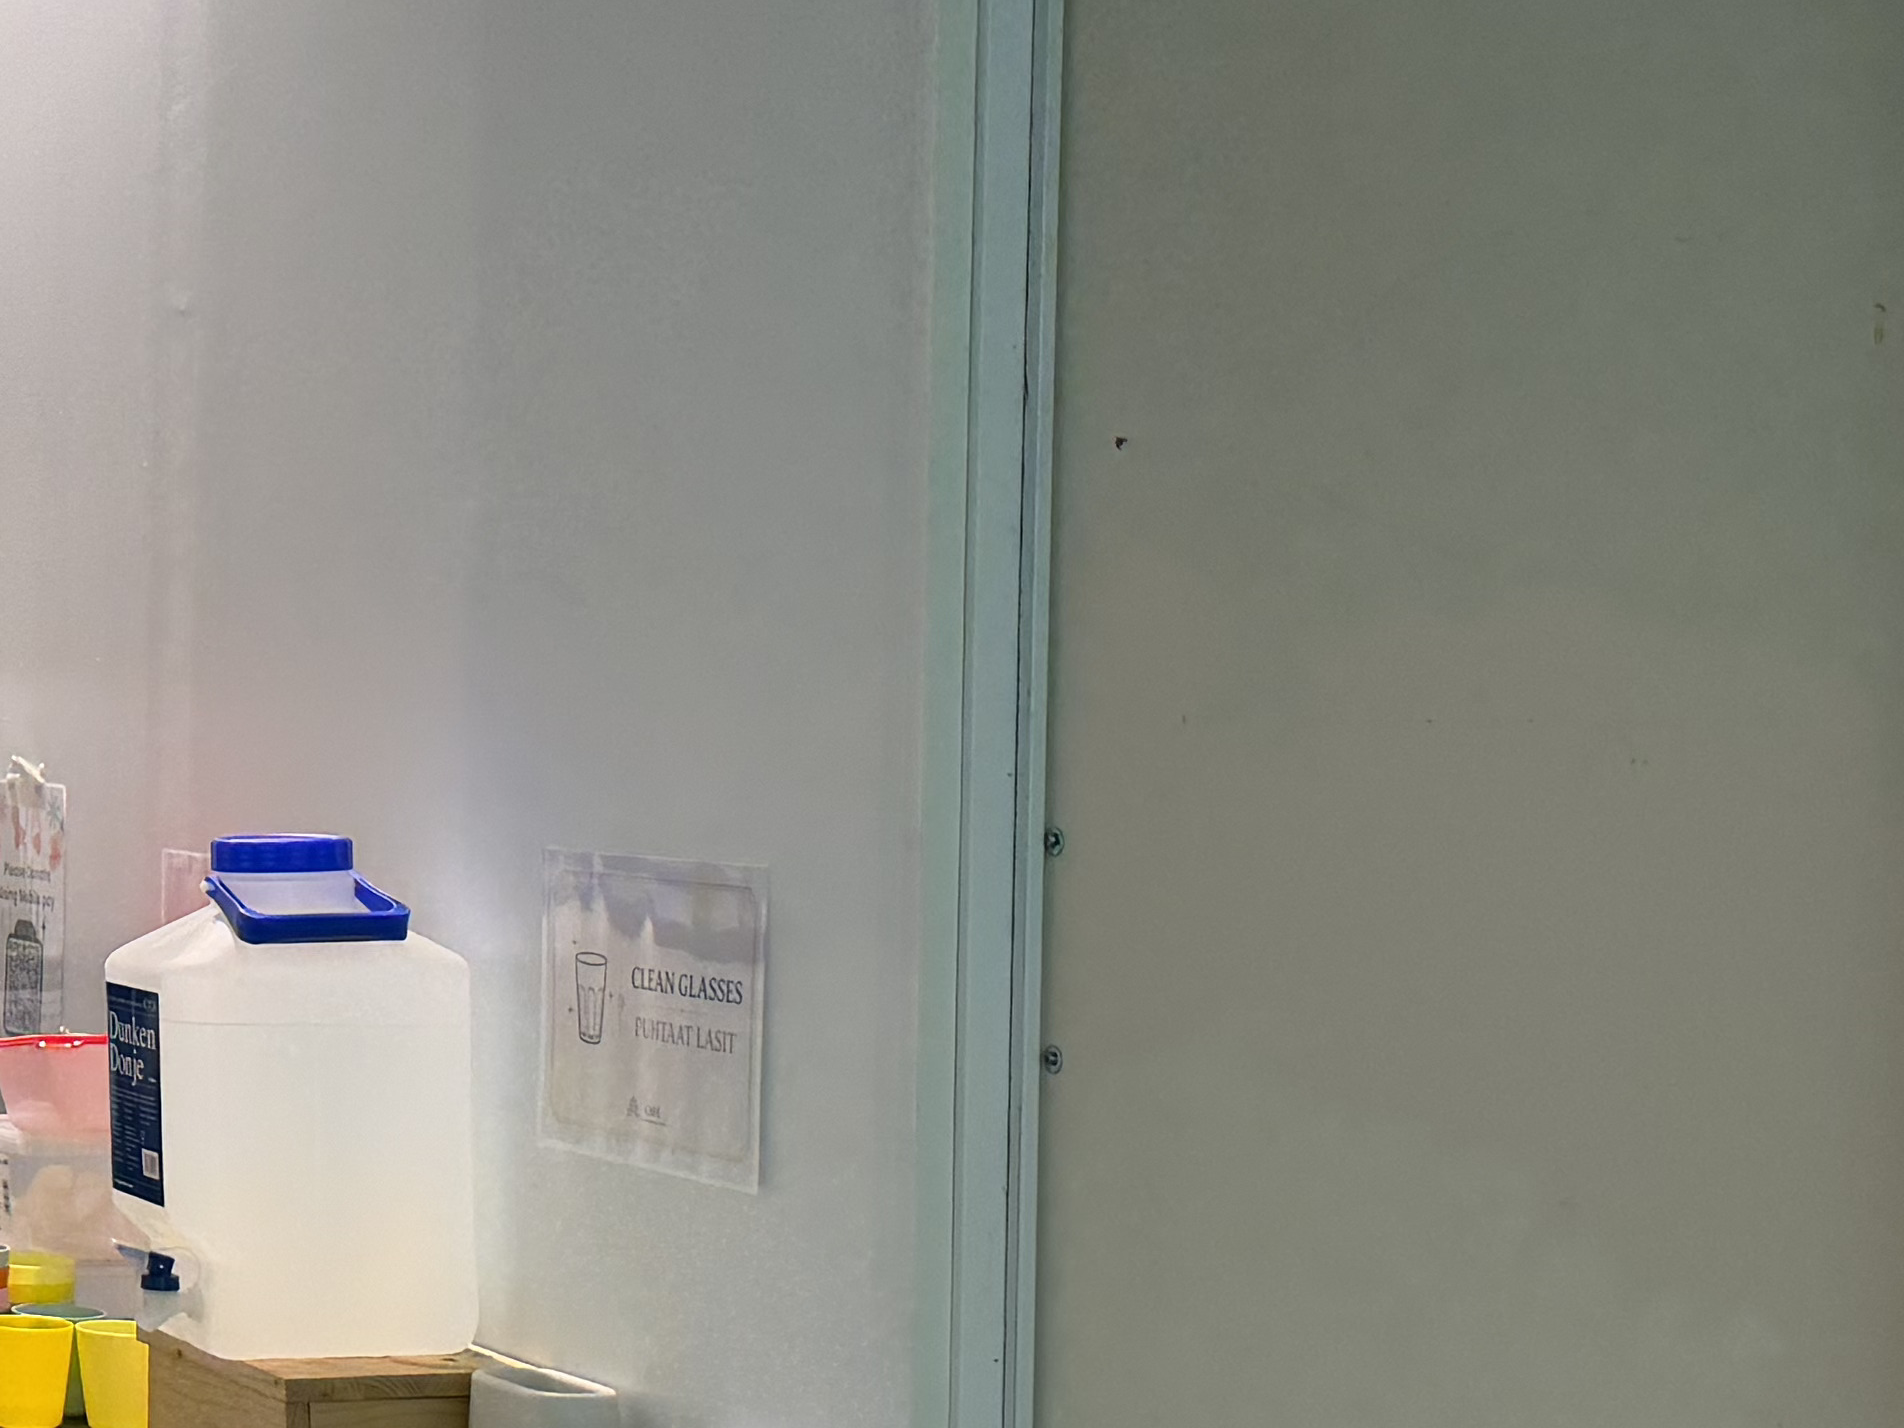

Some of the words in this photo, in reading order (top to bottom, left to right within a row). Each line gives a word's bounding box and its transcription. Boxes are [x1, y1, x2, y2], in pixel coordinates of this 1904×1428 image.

[631, 965, 676, 995] CLEAN
[678, 973, 743, 1006] GLASSES
[109, 1010, 157, 1050] Dunken
[635, 1016, 693, 1047] PUHTAAT
[696, 1026, 738, 1054] LASIT
[109, 1042, 145, 1086] Donje
